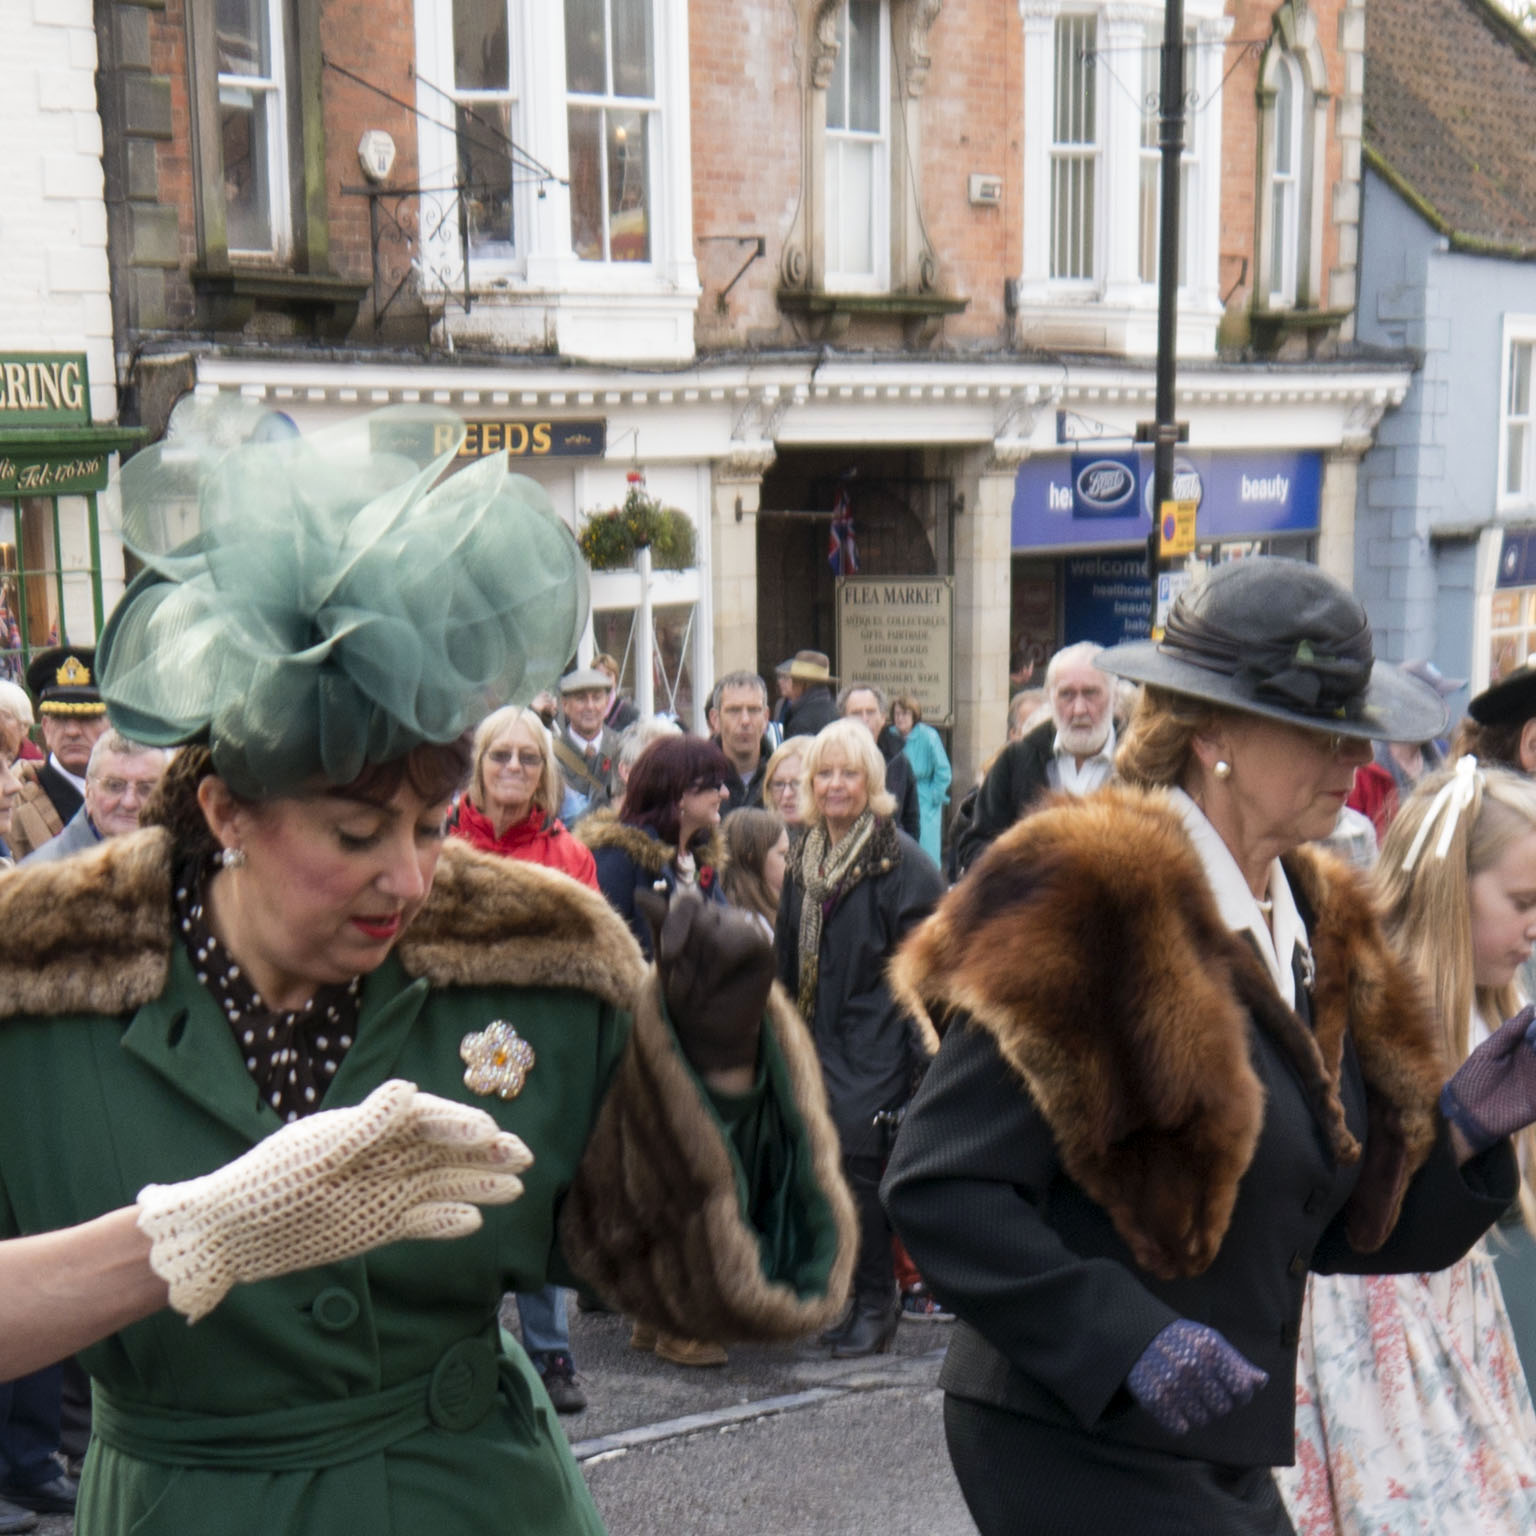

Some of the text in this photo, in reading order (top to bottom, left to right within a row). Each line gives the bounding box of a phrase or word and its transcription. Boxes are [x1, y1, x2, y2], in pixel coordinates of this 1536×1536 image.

[433, 422, 553, 457] REEDS
[1241, 474, 1289, 504] beauty
[845, 586, 942, 605] FLEA MARKET
